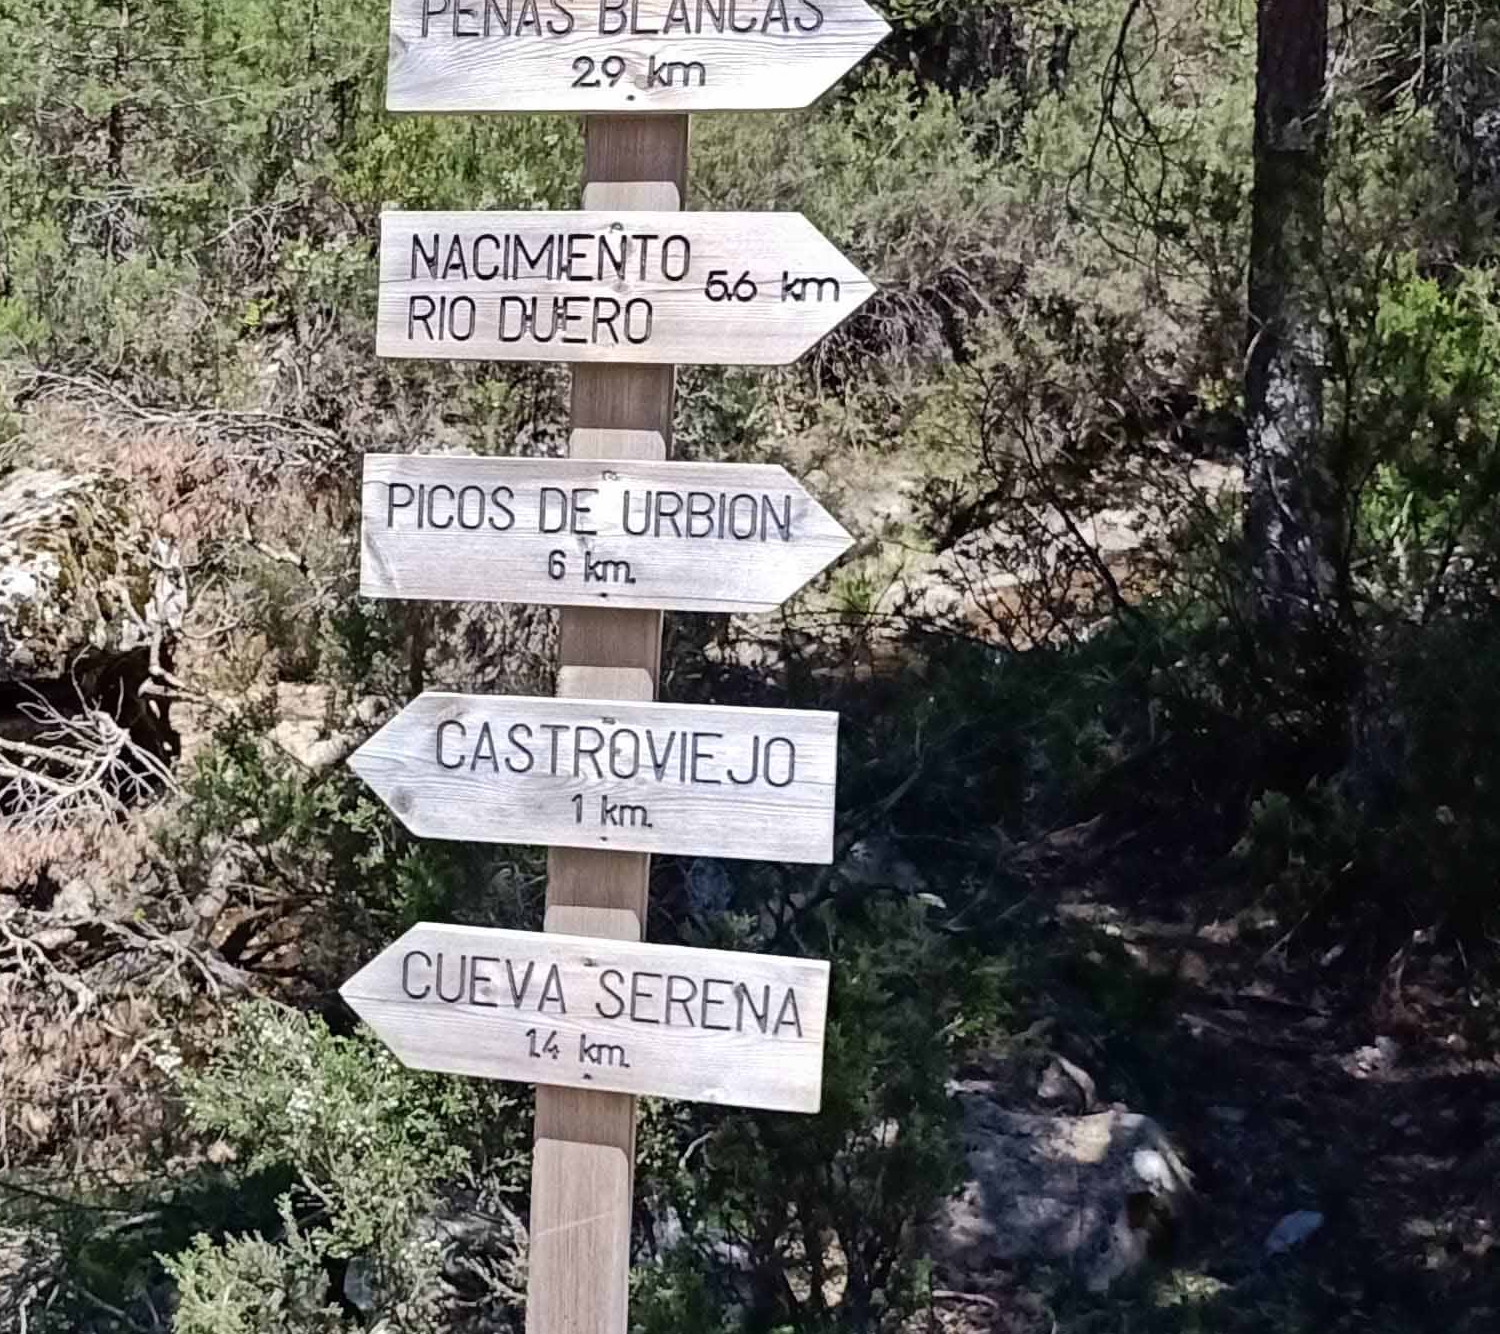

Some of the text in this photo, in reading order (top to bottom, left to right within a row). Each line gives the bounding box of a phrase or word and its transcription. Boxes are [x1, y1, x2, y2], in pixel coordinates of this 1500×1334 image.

[648, 54, 706, 87] km
[410, 233, 691, 282] NACIMIENTO
[781, 270, 840, 303] km
[407, 295, 653, 344] RIO DUERO
[387, 482, 791, 542] PICOS DE URBION
[547, 549, 566, 580] 6
[435, 719, 797, 788] CASTROVIEJO
[571, 792, 583, 824] 1
[401, 950, 803, 1038] CUEVA SERENA
